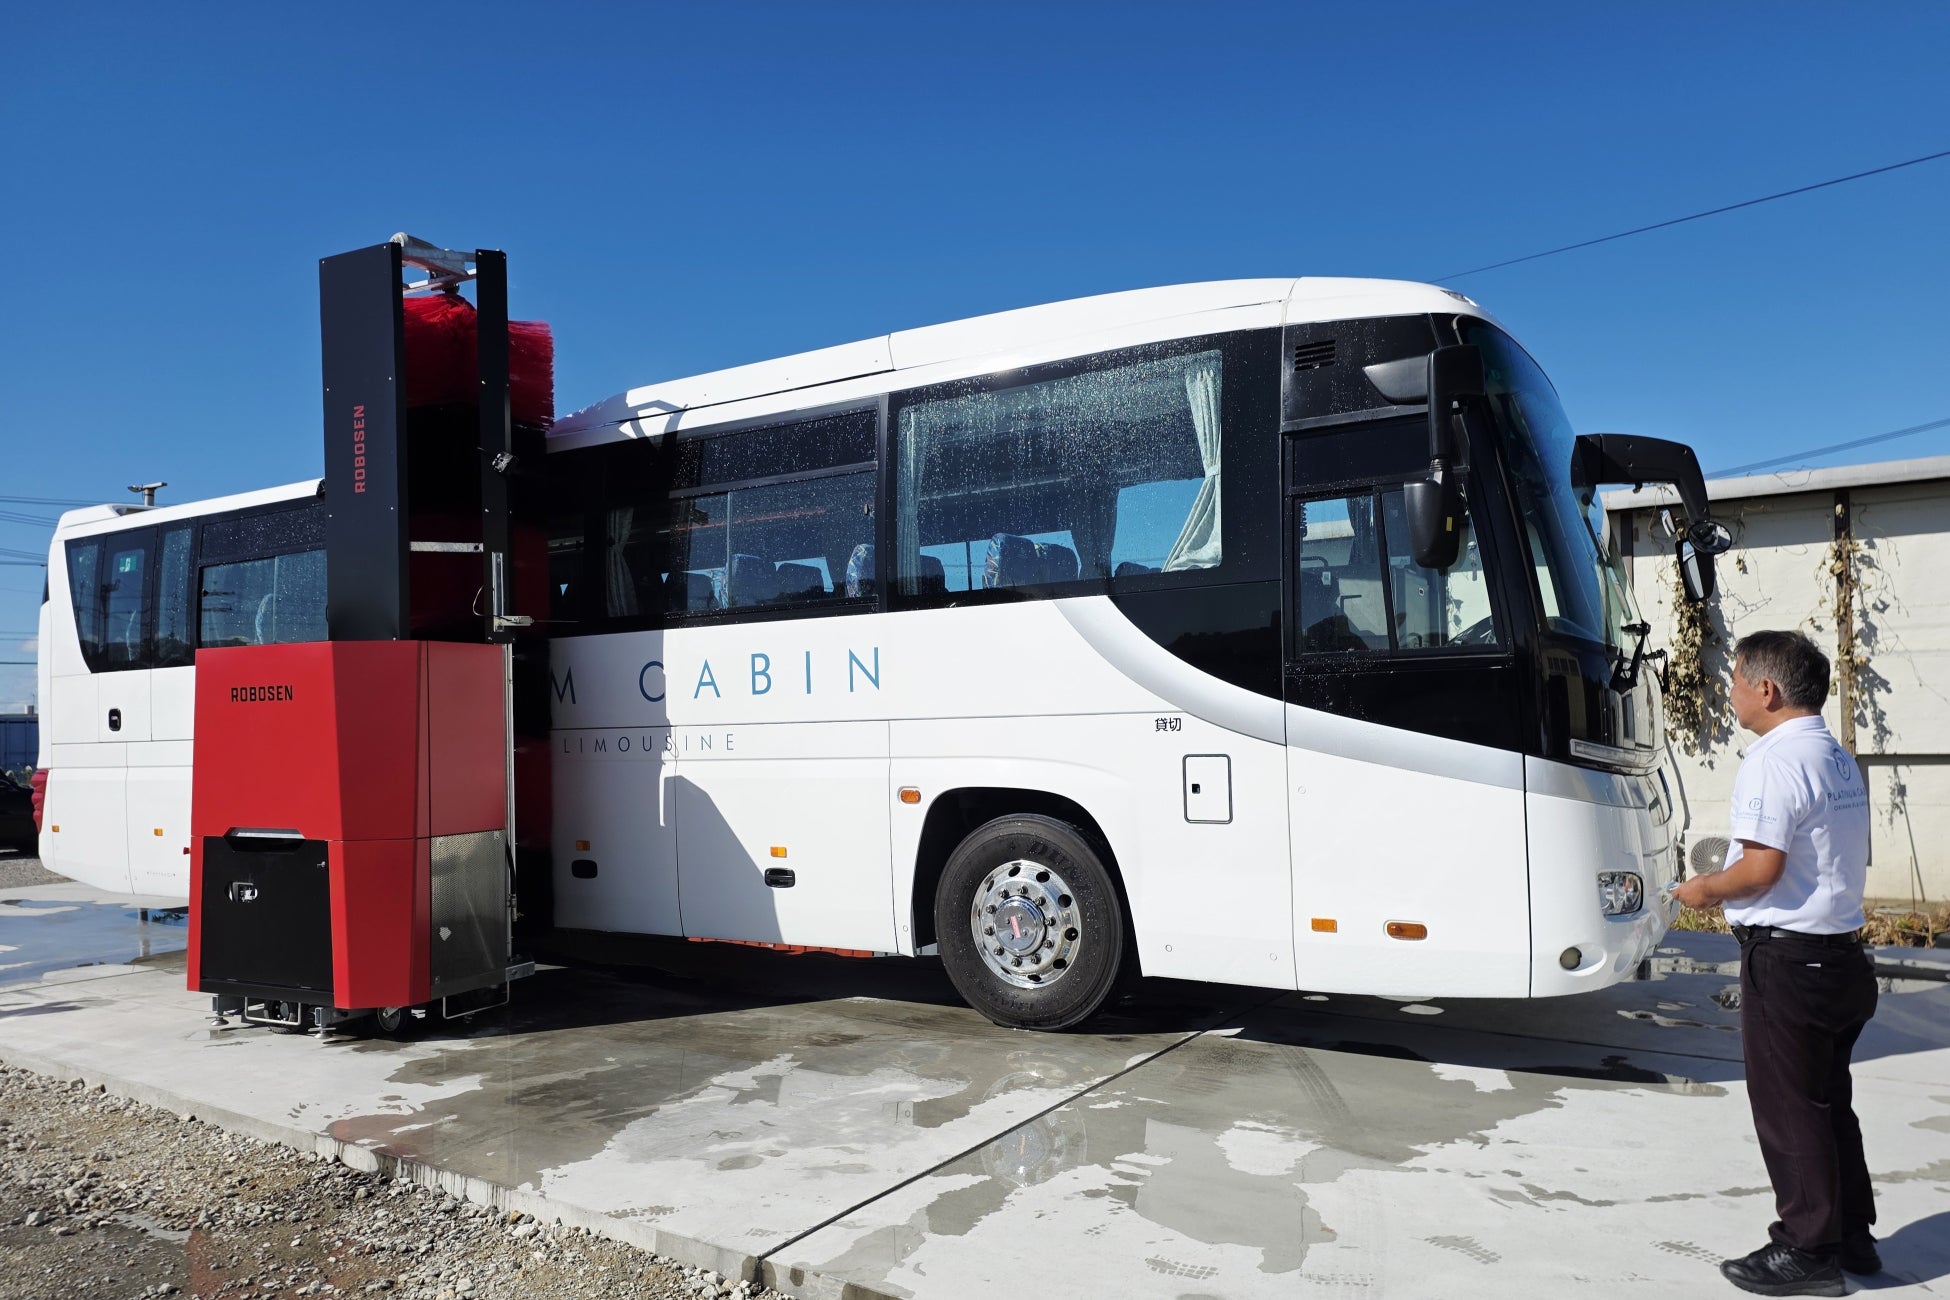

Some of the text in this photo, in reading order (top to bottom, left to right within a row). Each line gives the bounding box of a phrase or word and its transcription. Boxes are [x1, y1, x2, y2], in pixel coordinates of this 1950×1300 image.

[354, 404, 366, 493] ROBOSEN
[638, 647, 881, 703] CABIN
[231, 685, 294, 703] ROBOSEN
[1155, 717, 1182, 732] 貸切
[563, 733, 735, 754] LIMOUSINE
